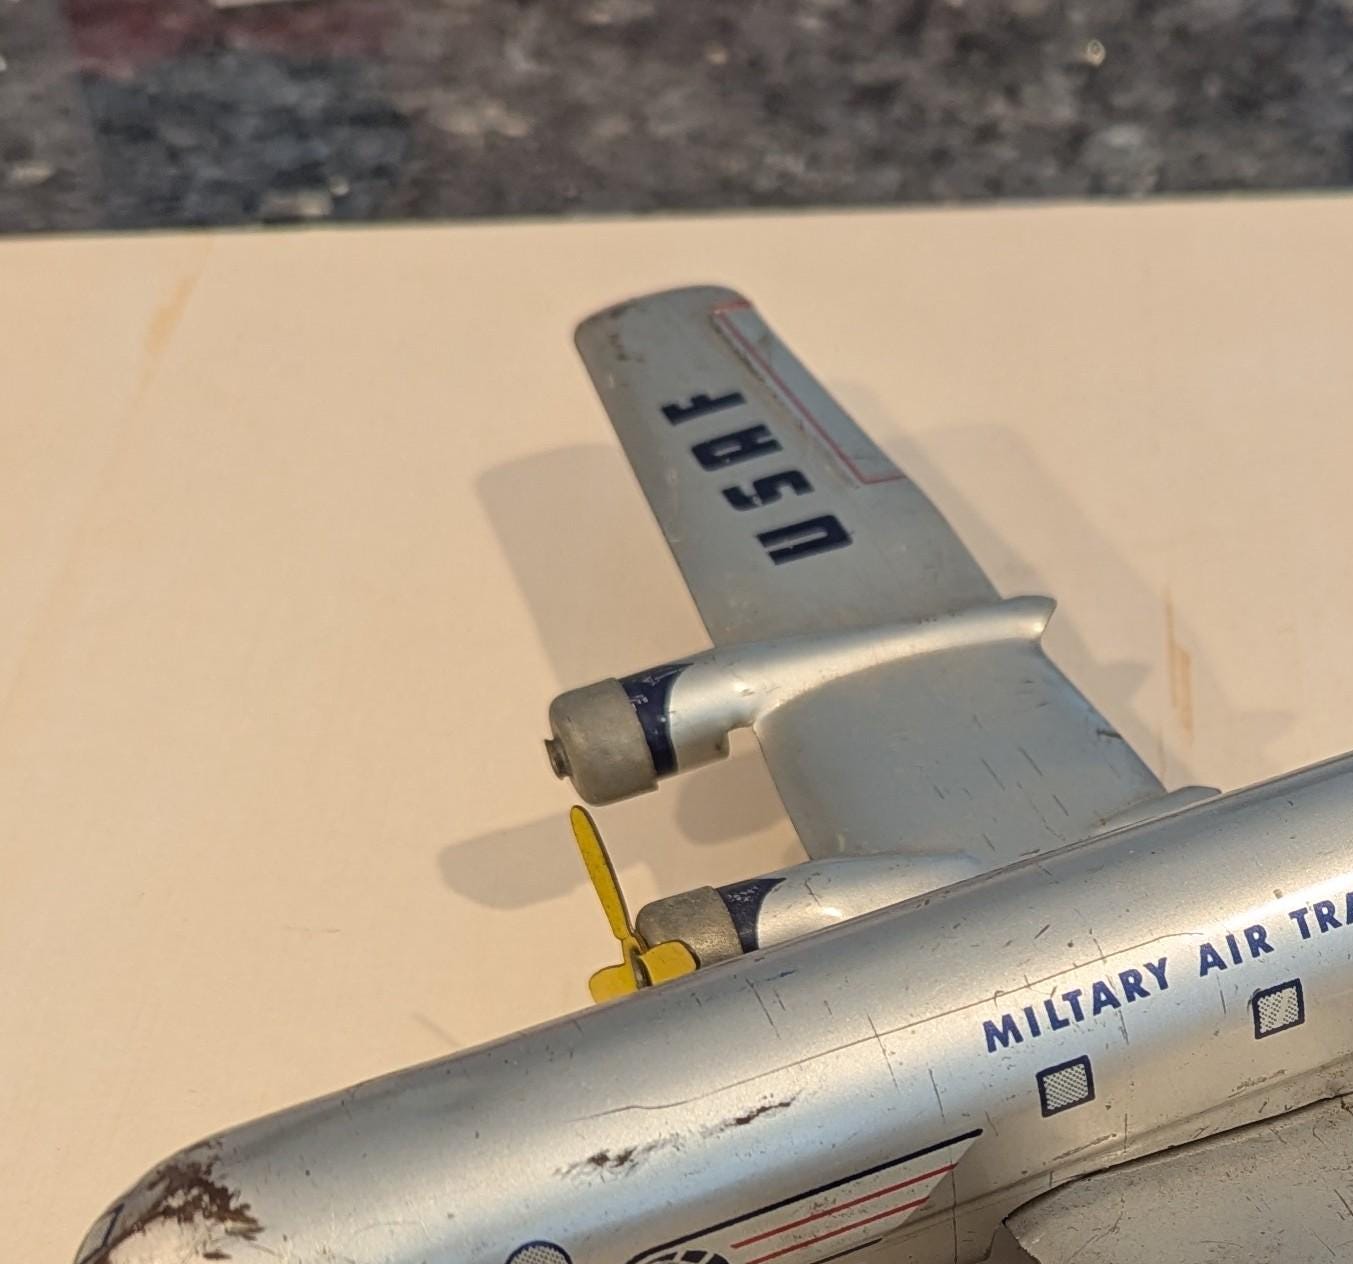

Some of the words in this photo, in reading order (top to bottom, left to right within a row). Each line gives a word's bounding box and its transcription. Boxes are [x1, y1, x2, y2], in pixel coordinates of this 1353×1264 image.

[660, 391, 853, 566] USAF
[983, 957, 1169, 1053] MILTARY
[1199, 922, 1274, 977] AIR
